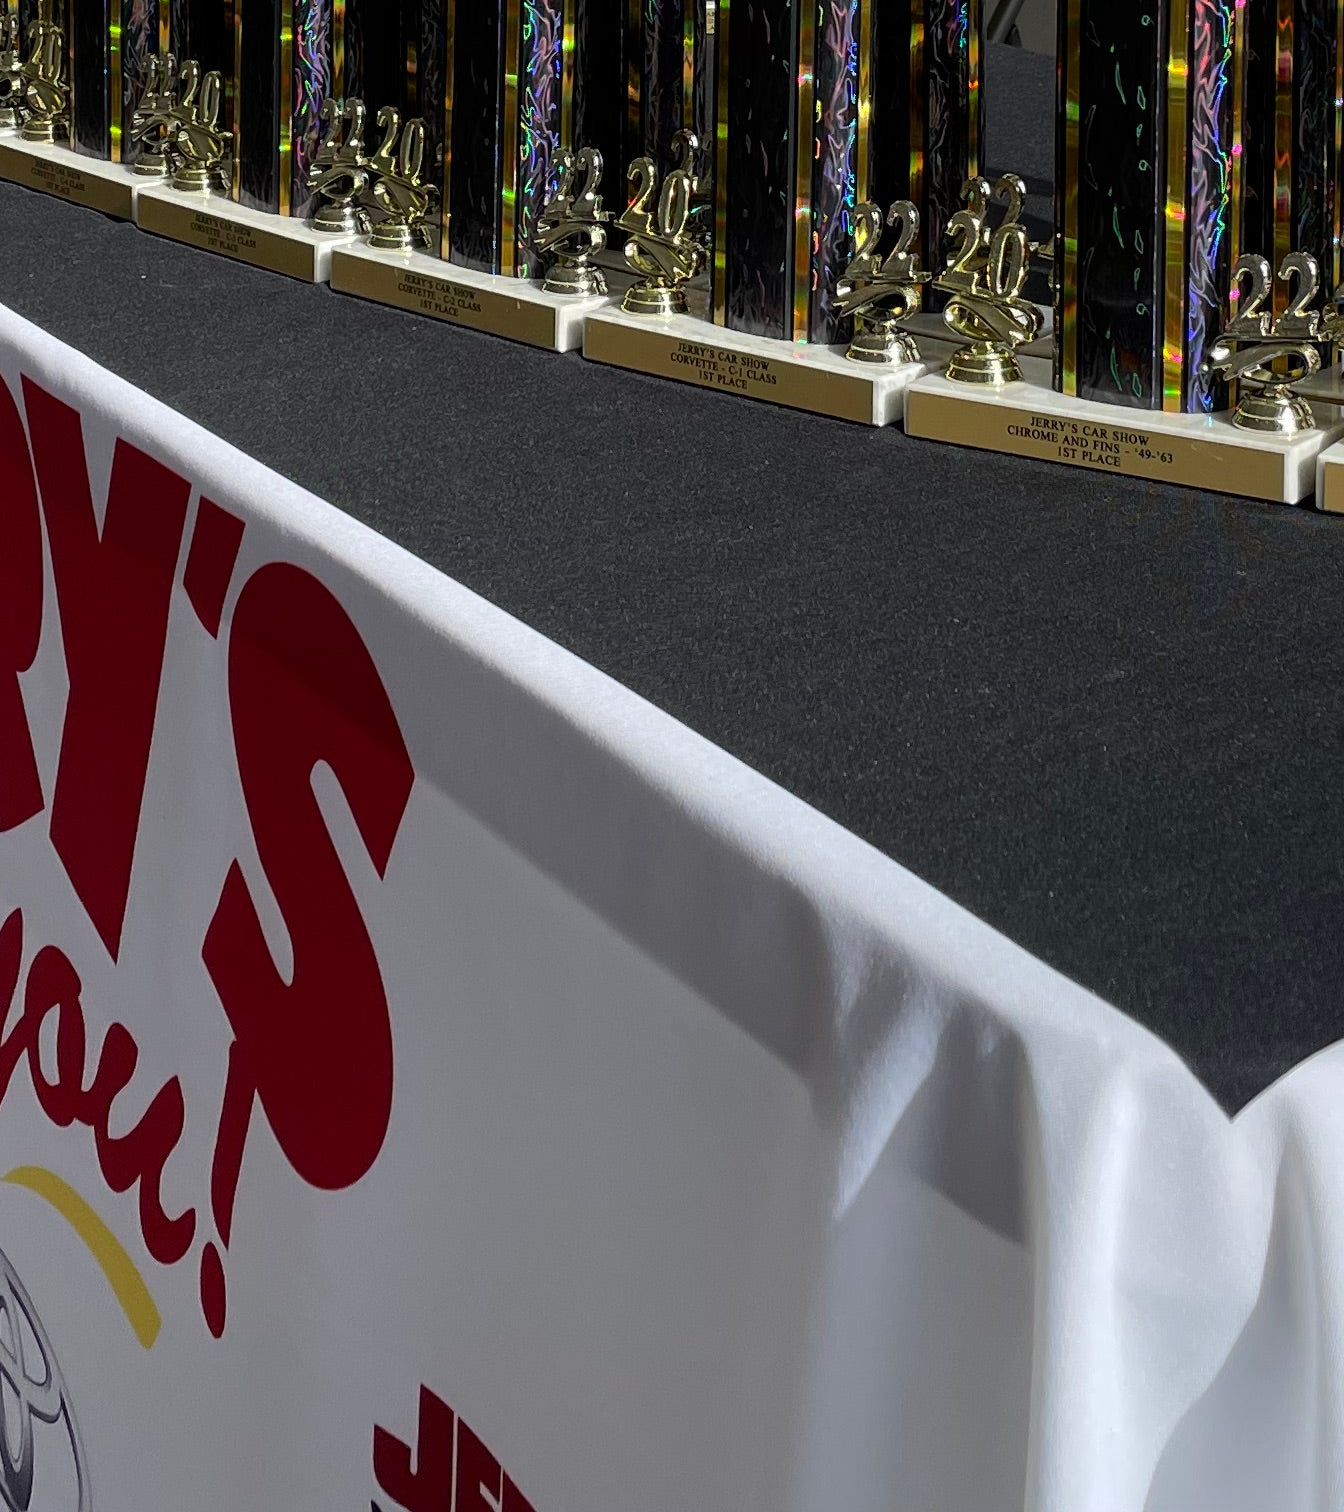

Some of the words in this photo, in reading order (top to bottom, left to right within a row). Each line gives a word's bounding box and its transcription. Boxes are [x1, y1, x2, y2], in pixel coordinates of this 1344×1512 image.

[671, 353, 718, 371] CORVETTE
[747, 370, 776, 384] CLASS
[678, 343, 715, 359] JERRY'S
[718, 352, 737, 364] CAR
[741, 357, 769, 370] SHOW
[699, 370, 714, 381] 1ST
[718, 374, 747, 389] PLACE
[1007, 425, 1058, 443] CHROME
[1063, 436, 1088, 447] AND
[1093, 440, 1120, 453] FINS
[1030, 417, 1078, 434] JERRY'S
[1083, 426, 1107, 438] CAR
[1113, 431, 1149, 445] SHOW
[1058, 447, 1077, 459] 1ST
[1082, 451, 1121, 467] PLACE
